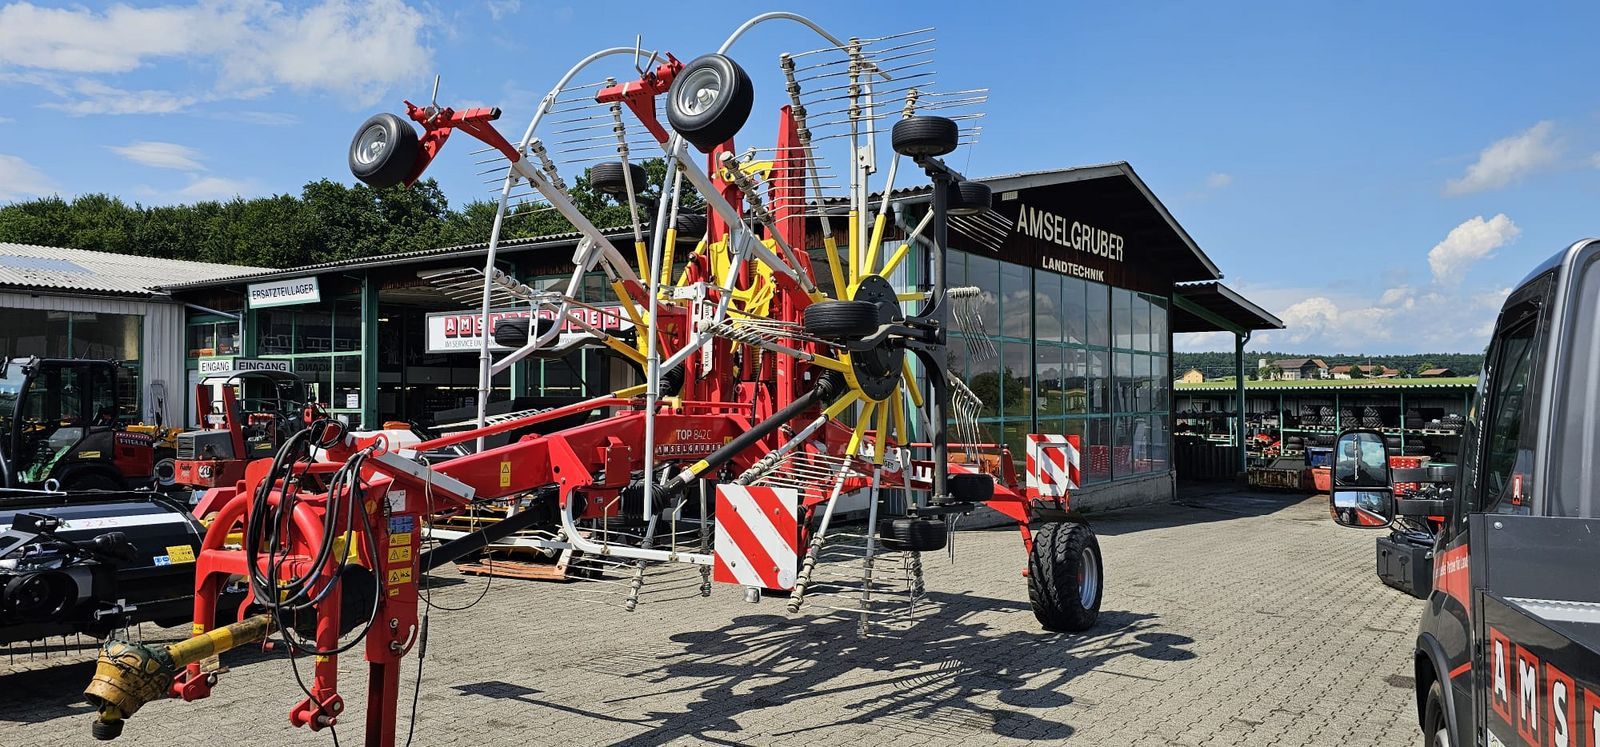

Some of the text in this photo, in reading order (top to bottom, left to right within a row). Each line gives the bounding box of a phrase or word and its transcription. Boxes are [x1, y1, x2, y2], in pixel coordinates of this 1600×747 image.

[1017, 203, 1124, 262] AMSELGRUBER
[1042, 255, 1104, 282] LANDTECHNIK
[252, 283, 314, 300] ERSATZTEILLAGER
[201, 361, 230, 372] EINGANG
[238, 361, 287, 371] EINGANG
[676, 429, 712, 440] TOP 842C
[1492, 634, 1600, 747] AMS
